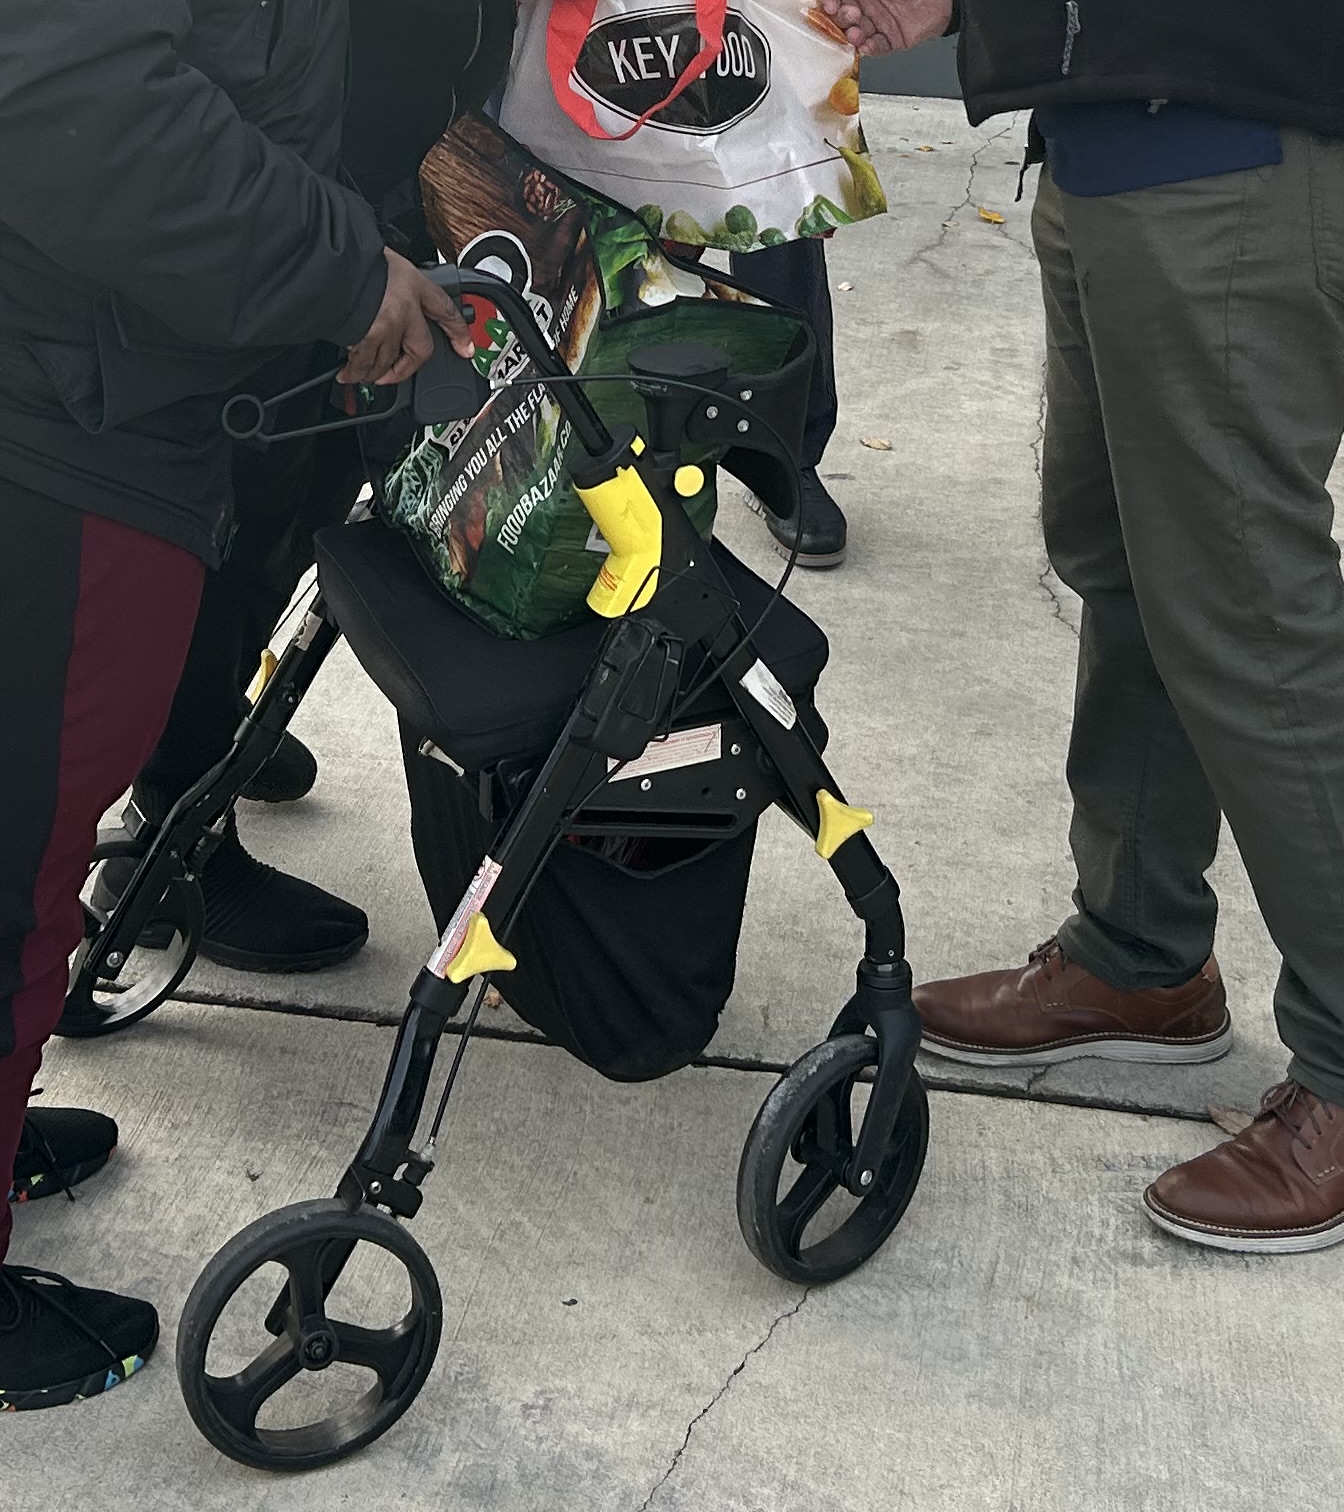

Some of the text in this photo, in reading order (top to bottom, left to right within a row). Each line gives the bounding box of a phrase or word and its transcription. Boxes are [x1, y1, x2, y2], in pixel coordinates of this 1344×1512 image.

[607, 31, 757, 84] KEY OOD
[429, 474, 468, 539] BRINGING
[464, 448, 488, 483] YOU
[486, 427, 508, 463] ALL
[504, 401, 533, 435] THE
[559, 285, 580, 332] HOME
